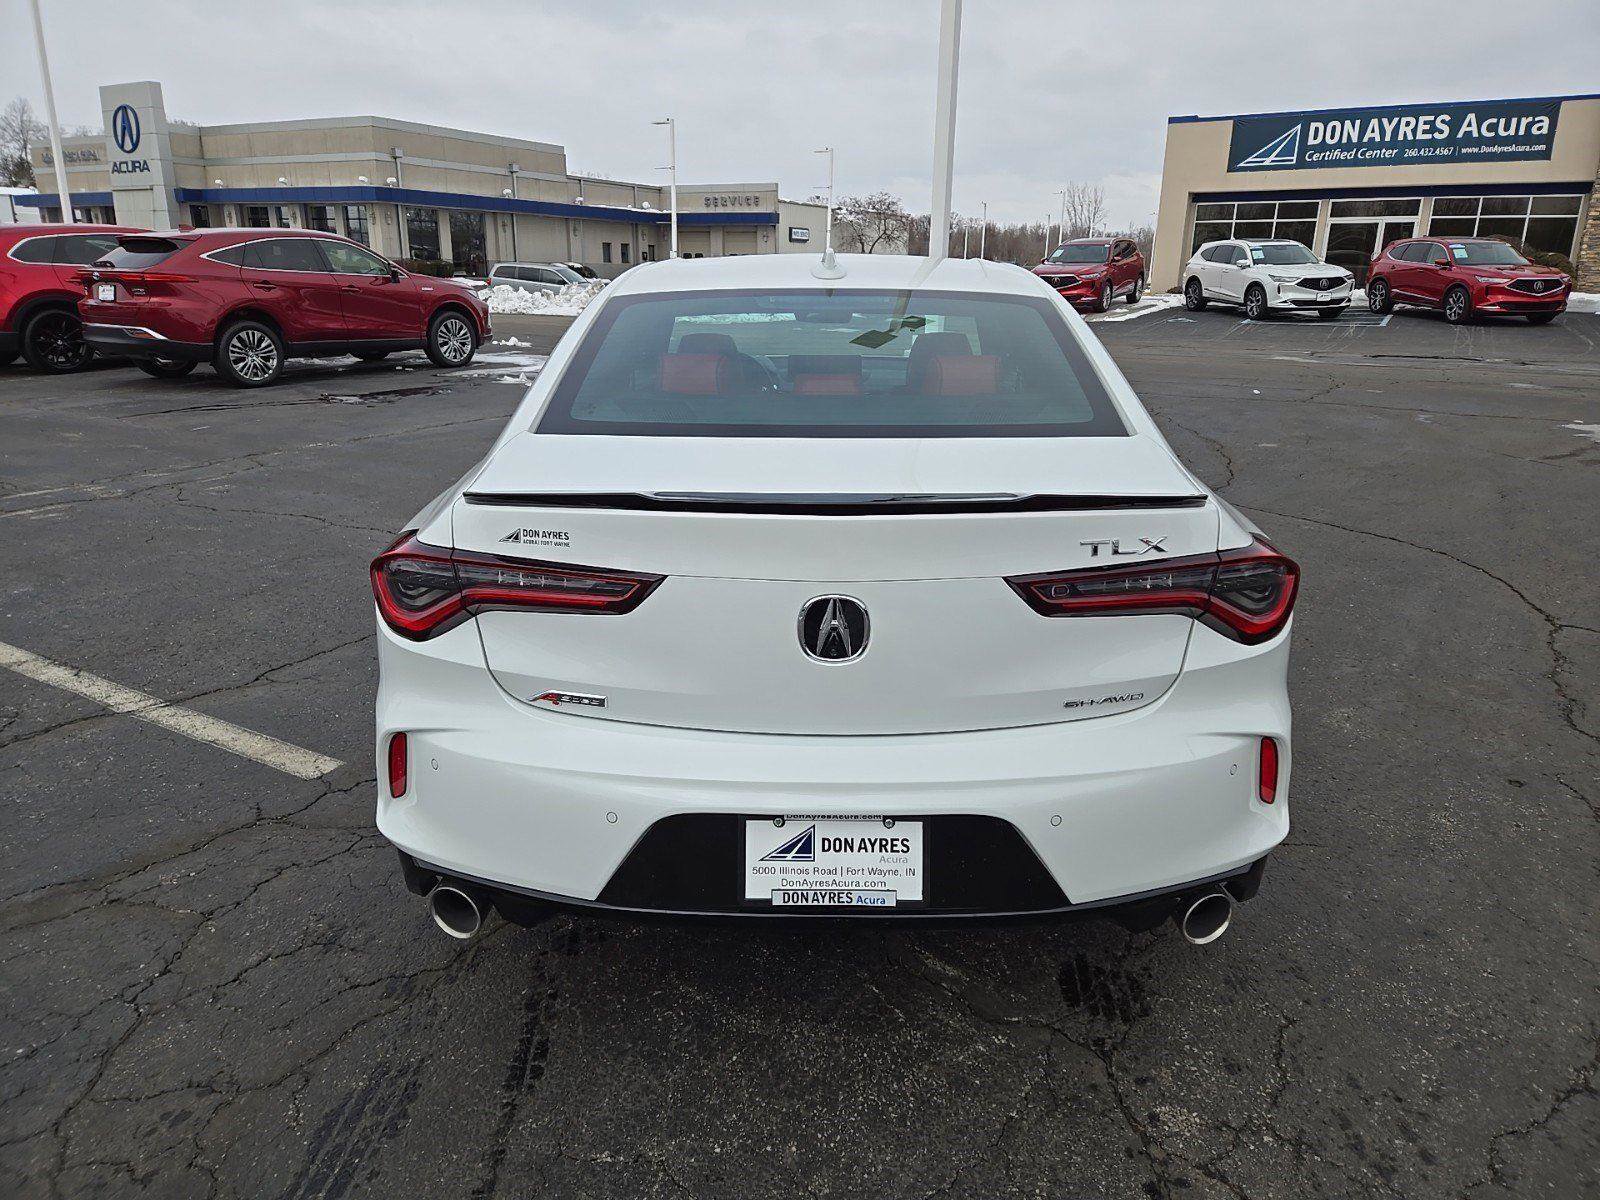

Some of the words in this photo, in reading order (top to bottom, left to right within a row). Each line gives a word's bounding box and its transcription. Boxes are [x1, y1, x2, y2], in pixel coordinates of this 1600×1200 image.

[1307, 120, 1359, 146] DON
[1362, 114, 1451, 143] AYRES
[1456, 112, 1550, 139] Acura
[1305, 148, 1356, 163] Certified
[1357, 147, 1399, 160] Center
[1403, 146, 1454, 158] 260.432.4567
[111, 160, 151, 174] ACURA
[704, 195, 760, 207] SERVICE
[522, 529, 540, 538] DON
[541, 530, 569, 540] AYRES
[1080, 536, 1168, 557] TLX
[821, 838, 854, 853] DON
[857, 838, 910, 854] AYRES
[879, 855, 908, 864] Acura
[752, 866, 776, 875] 5000
[779, 866, 810, 876] Illinois
[813, 867, 838, 876] Road
[846, 867, 865, 876] Fort
[867, 867, 902, 878] Wayne,
[905, 868, 916, 876] IN
[781, 878, 887, 889] DonAyresAcura.com
[782, 892, 811, 904] DON
[812, 892, 853, 904] AYRES
[856, 895, 886, 905] Acura
